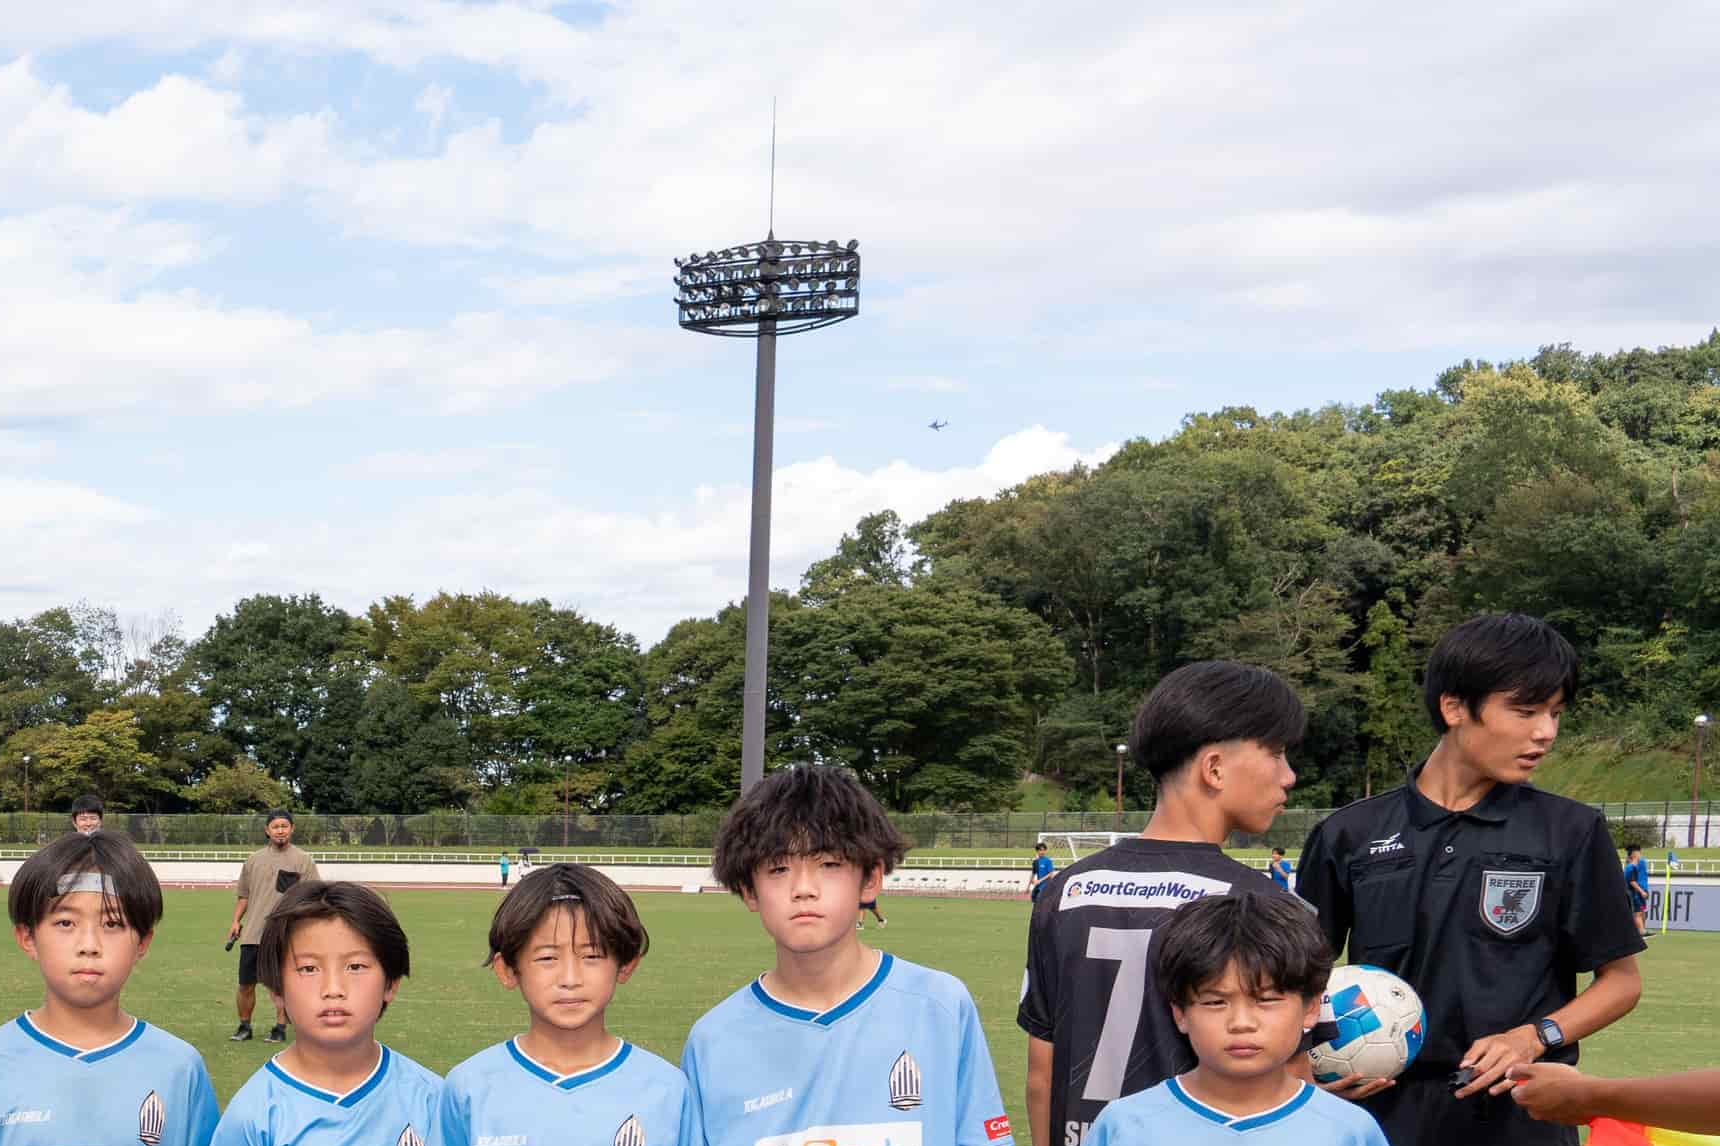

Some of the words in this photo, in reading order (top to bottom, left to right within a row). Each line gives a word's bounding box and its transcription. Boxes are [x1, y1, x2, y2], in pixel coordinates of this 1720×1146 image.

[1489, 879, 1536, 888] REFEREE
[1496, 914, 1519, 923] JFA
[1082, 927, 1152, 1100] 7
